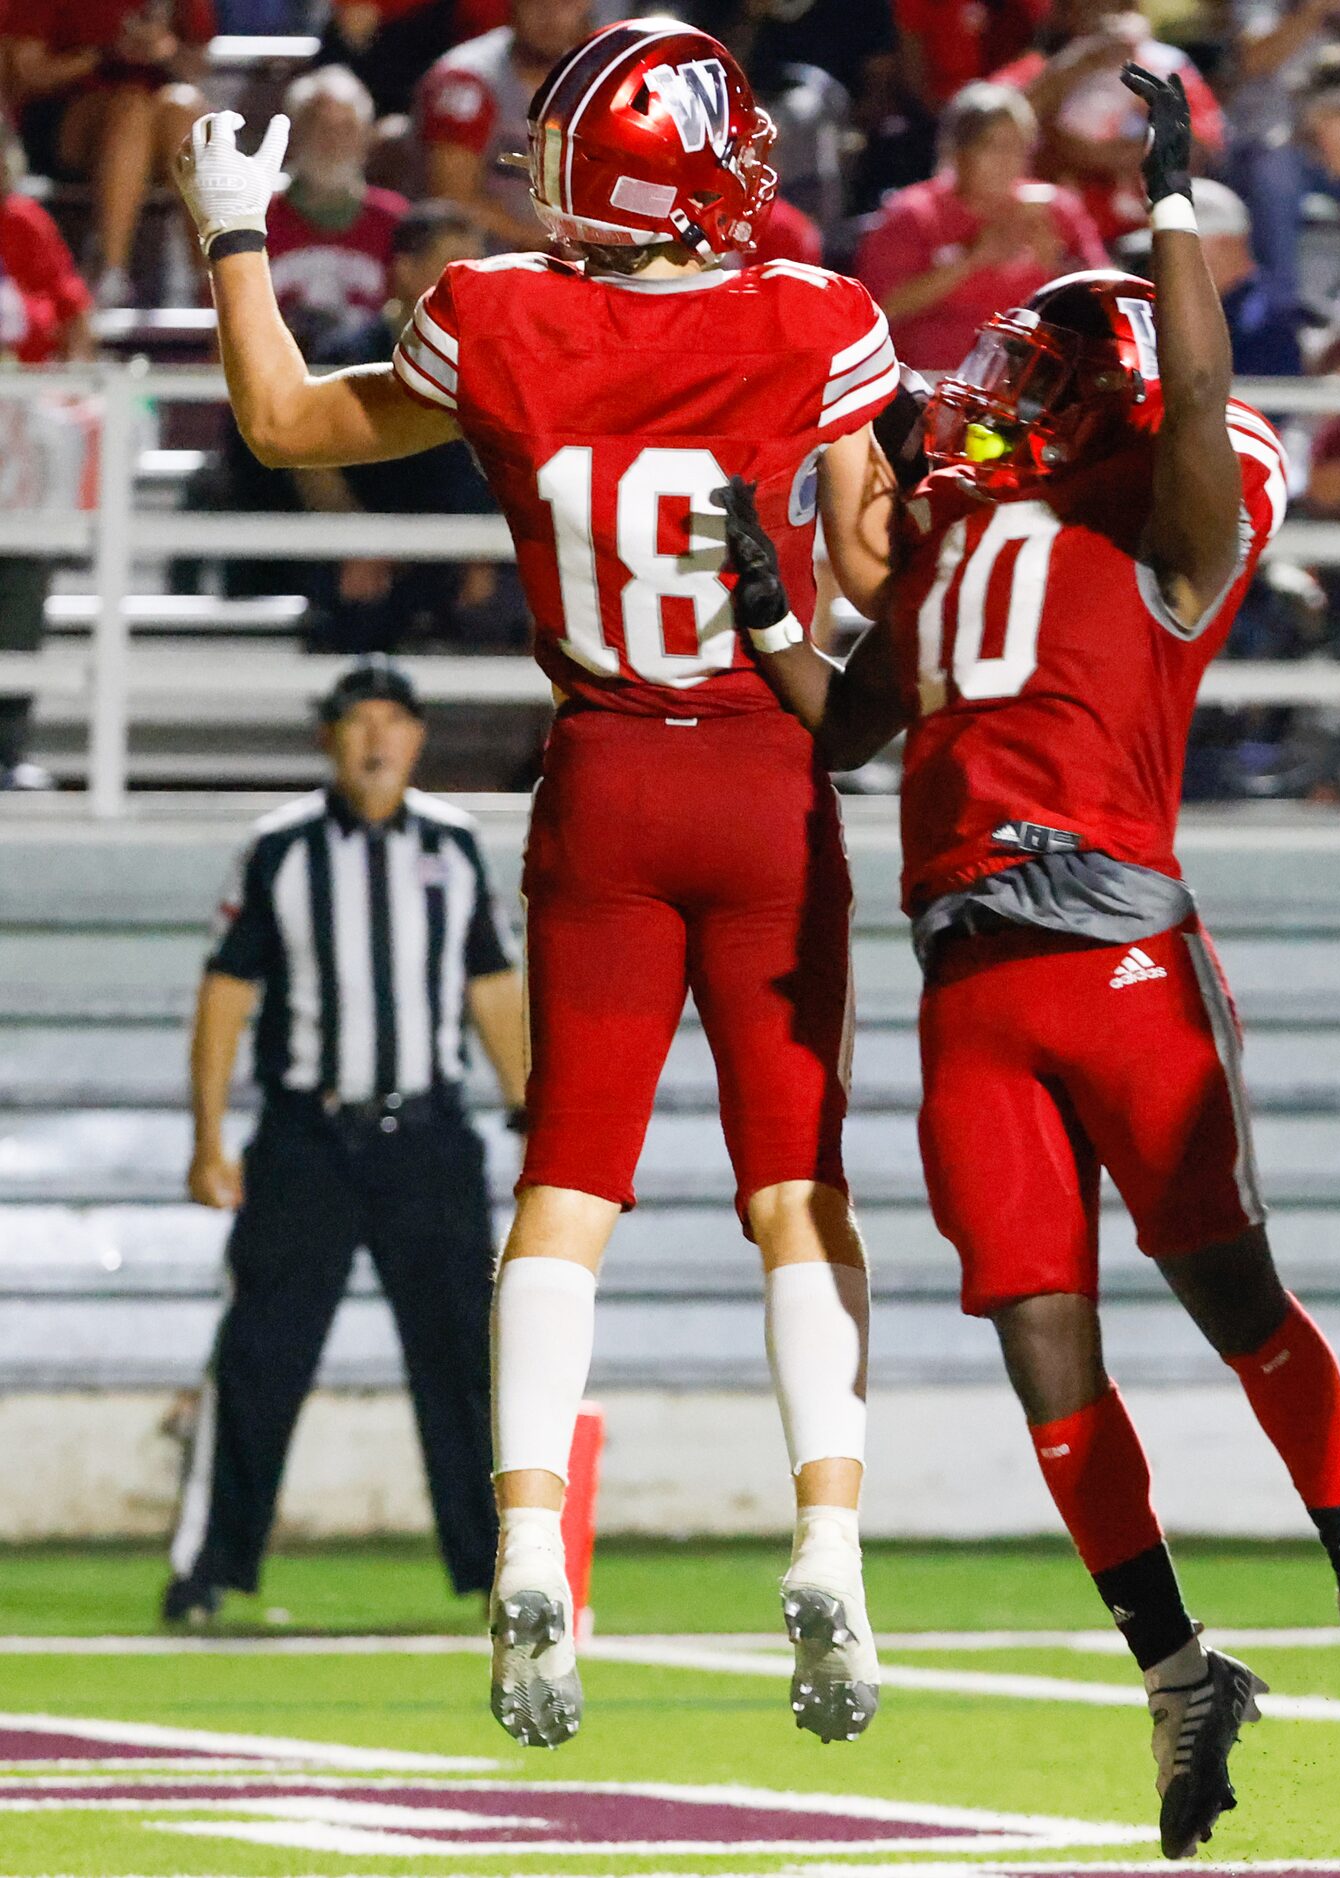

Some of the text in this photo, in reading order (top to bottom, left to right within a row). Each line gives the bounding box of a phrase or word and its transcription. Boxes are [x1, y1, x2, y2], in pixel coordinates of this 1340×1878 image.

[642, 59, 728, 157] W
[537, 446, 736, 689] 18
[917, 500, 1063, 716] 10
[1109, 966, 1168, 989] adidas
